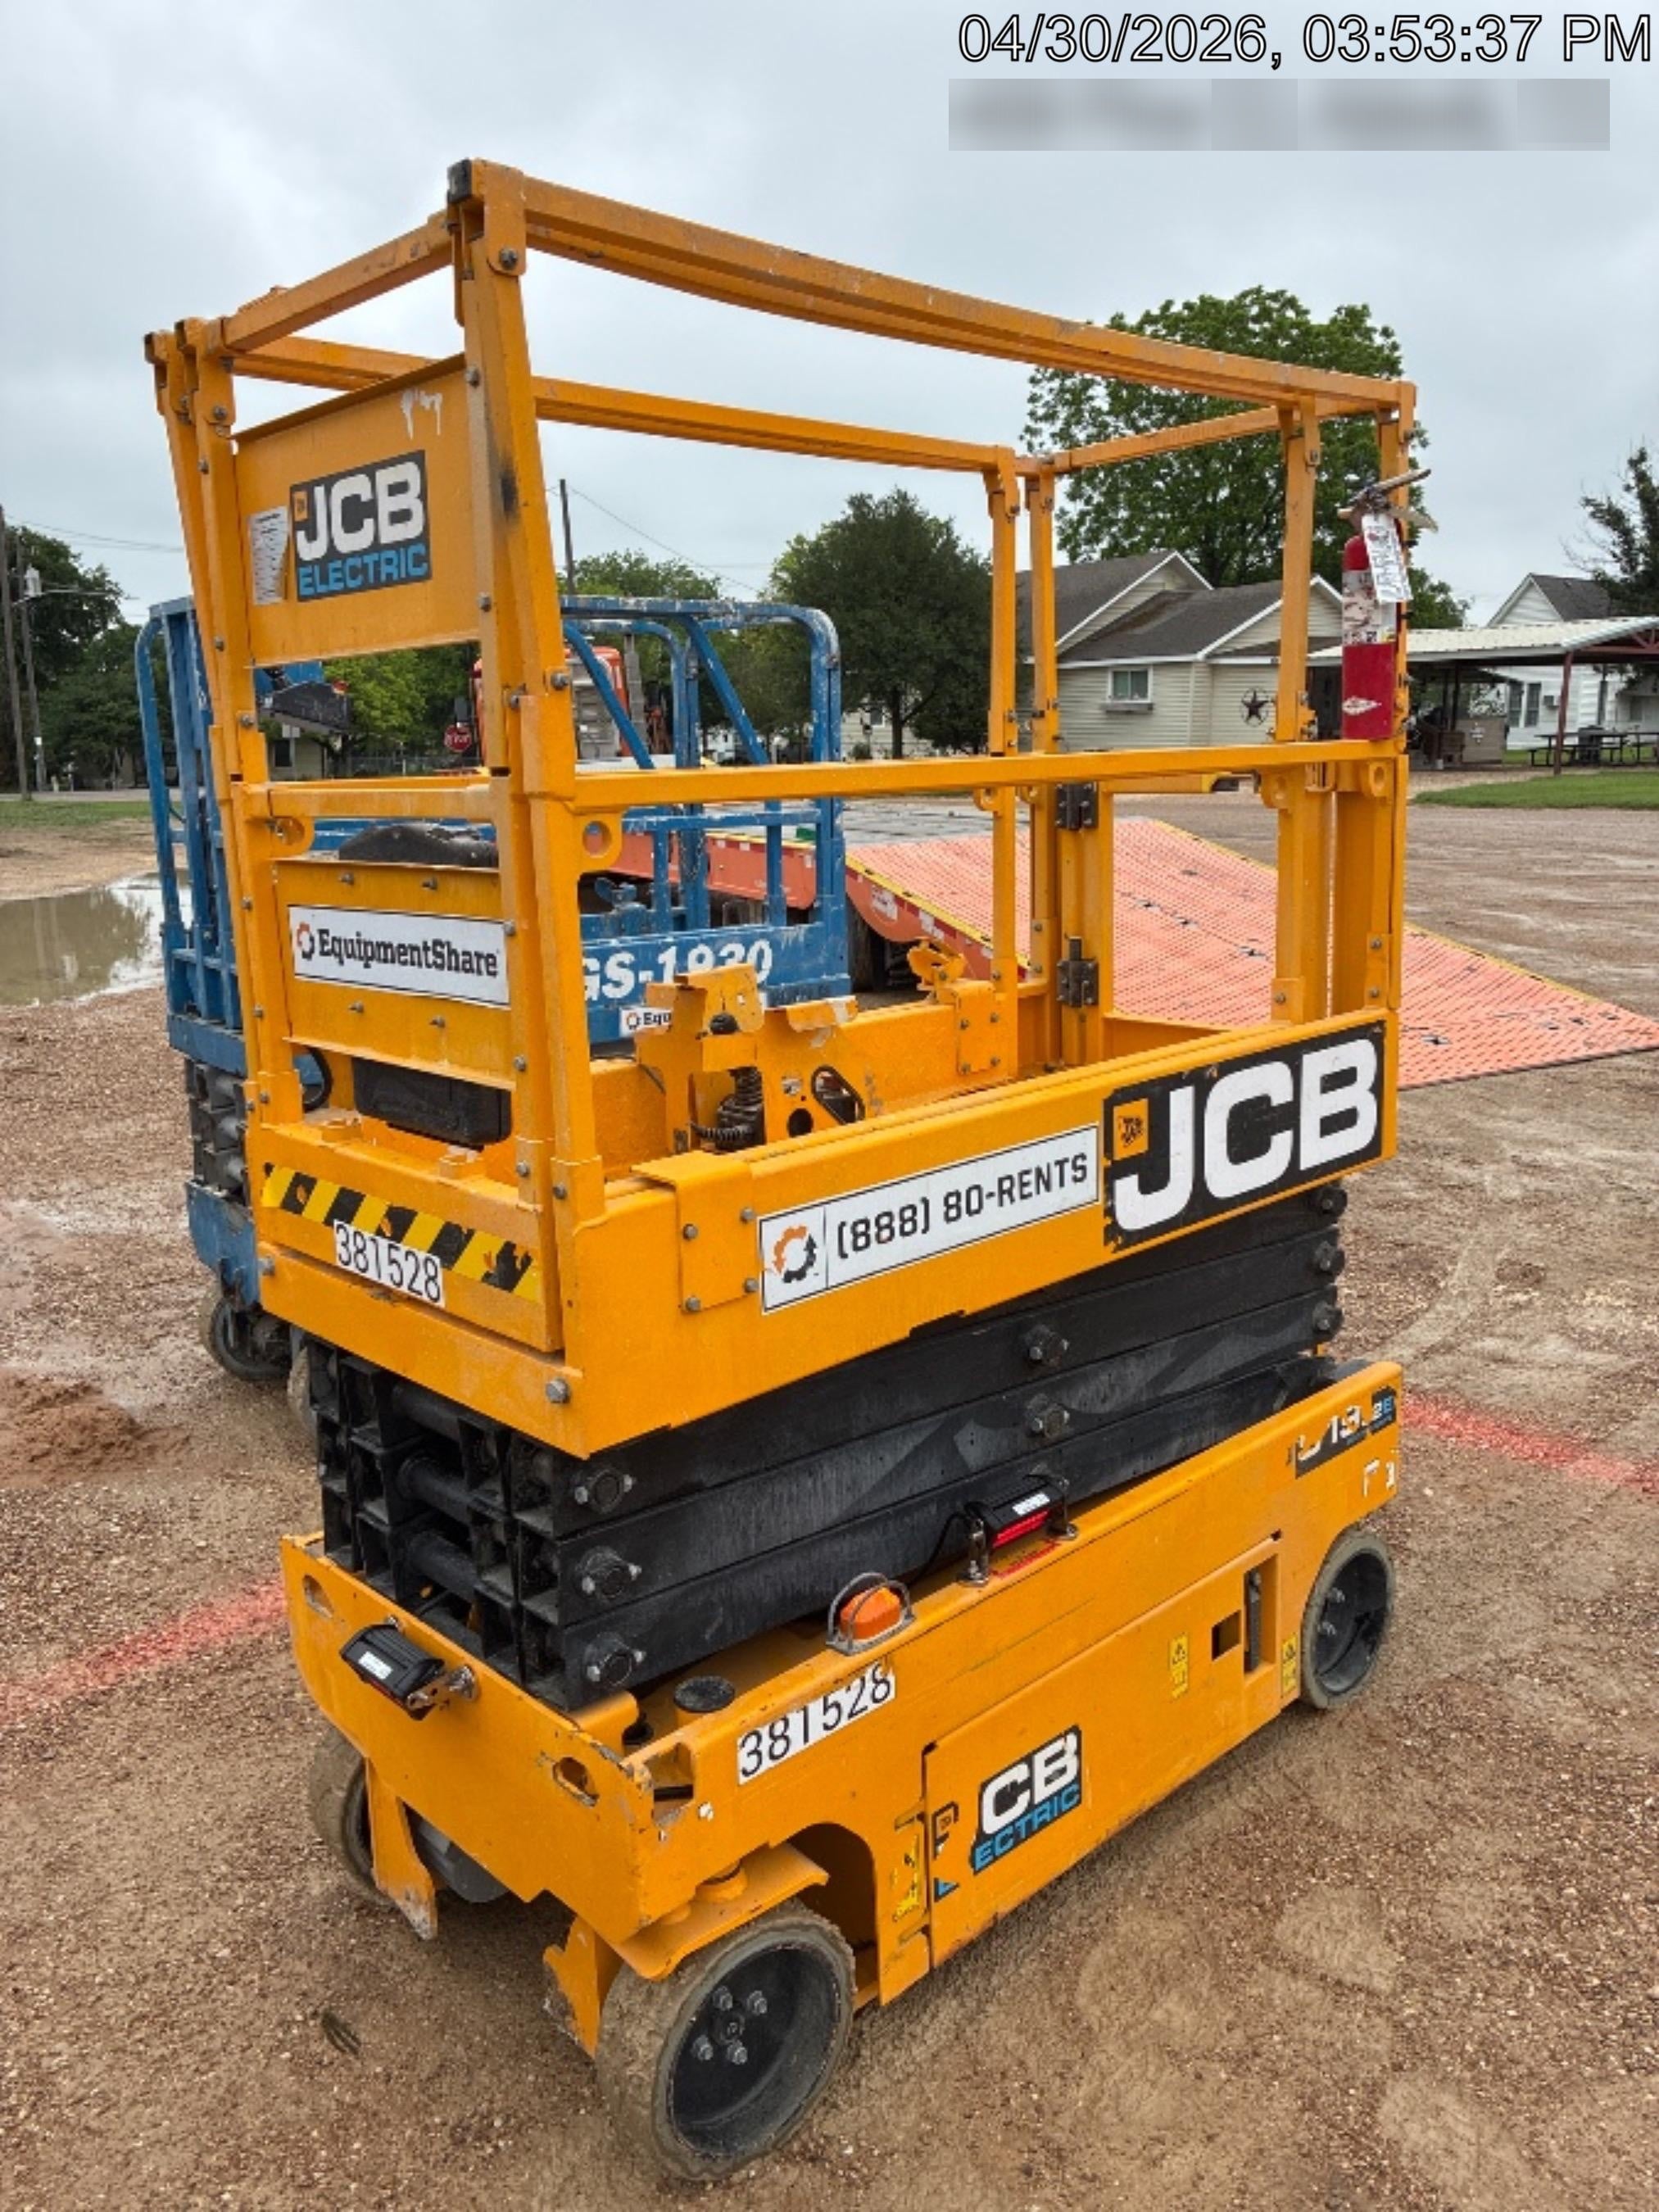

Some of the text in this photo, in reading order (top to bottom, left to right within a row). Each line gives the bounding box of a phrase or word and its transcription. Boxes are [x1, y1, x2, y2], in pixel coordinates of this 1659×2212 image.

[296, 461, 424, 561] JCB
[298, 544, 428, 596] ELECTRIC
[317, 928, 499, 977] EquipmentShare
[1114, 1039, 1378, 1231] JCB
[836, 1152, 1088, 1259] (888) 80-RENTS
[335, 1224, 442, 1303] 381528
[740, 1664, 891, 1778] 381528
[974, 1784, 1081, 1872] ECTRIC
[982, 1731, 1079, 1834] CB
